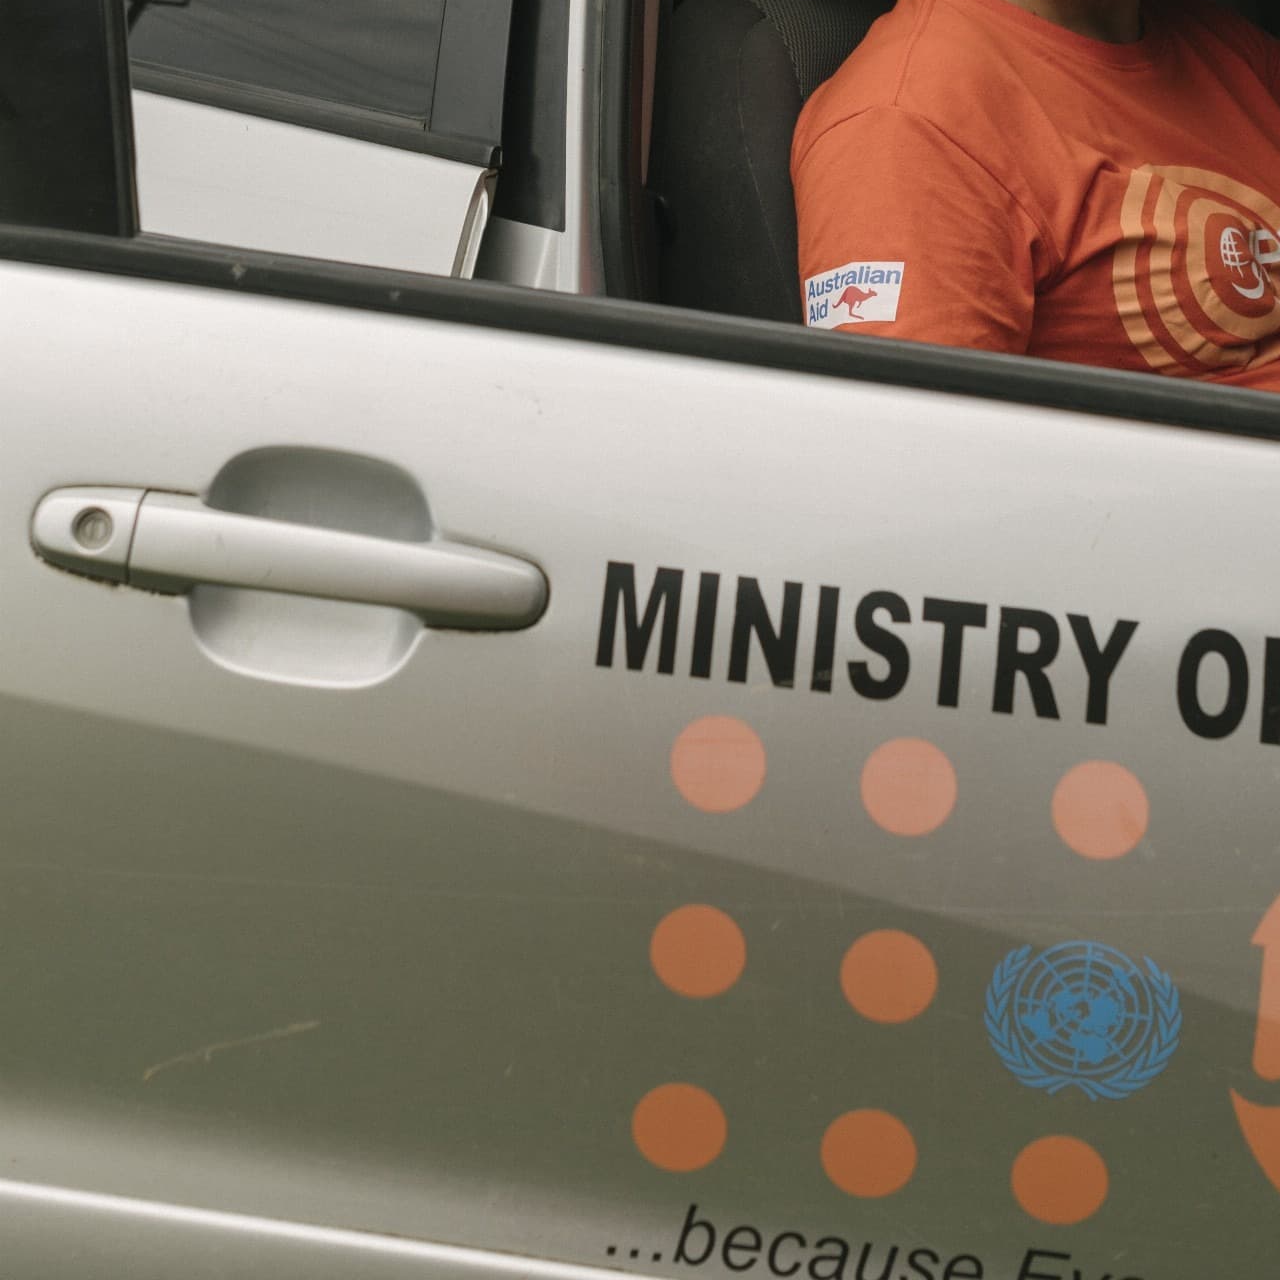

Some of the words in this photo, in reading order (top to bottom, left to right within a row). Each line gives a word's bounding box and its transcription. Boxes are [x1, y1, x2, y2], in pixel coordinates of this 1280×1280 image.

[807, 265, 902, 301] Australian
[809, 298, 829, 325] Aid
[594, 560, 1140, 726] MINISTRY
